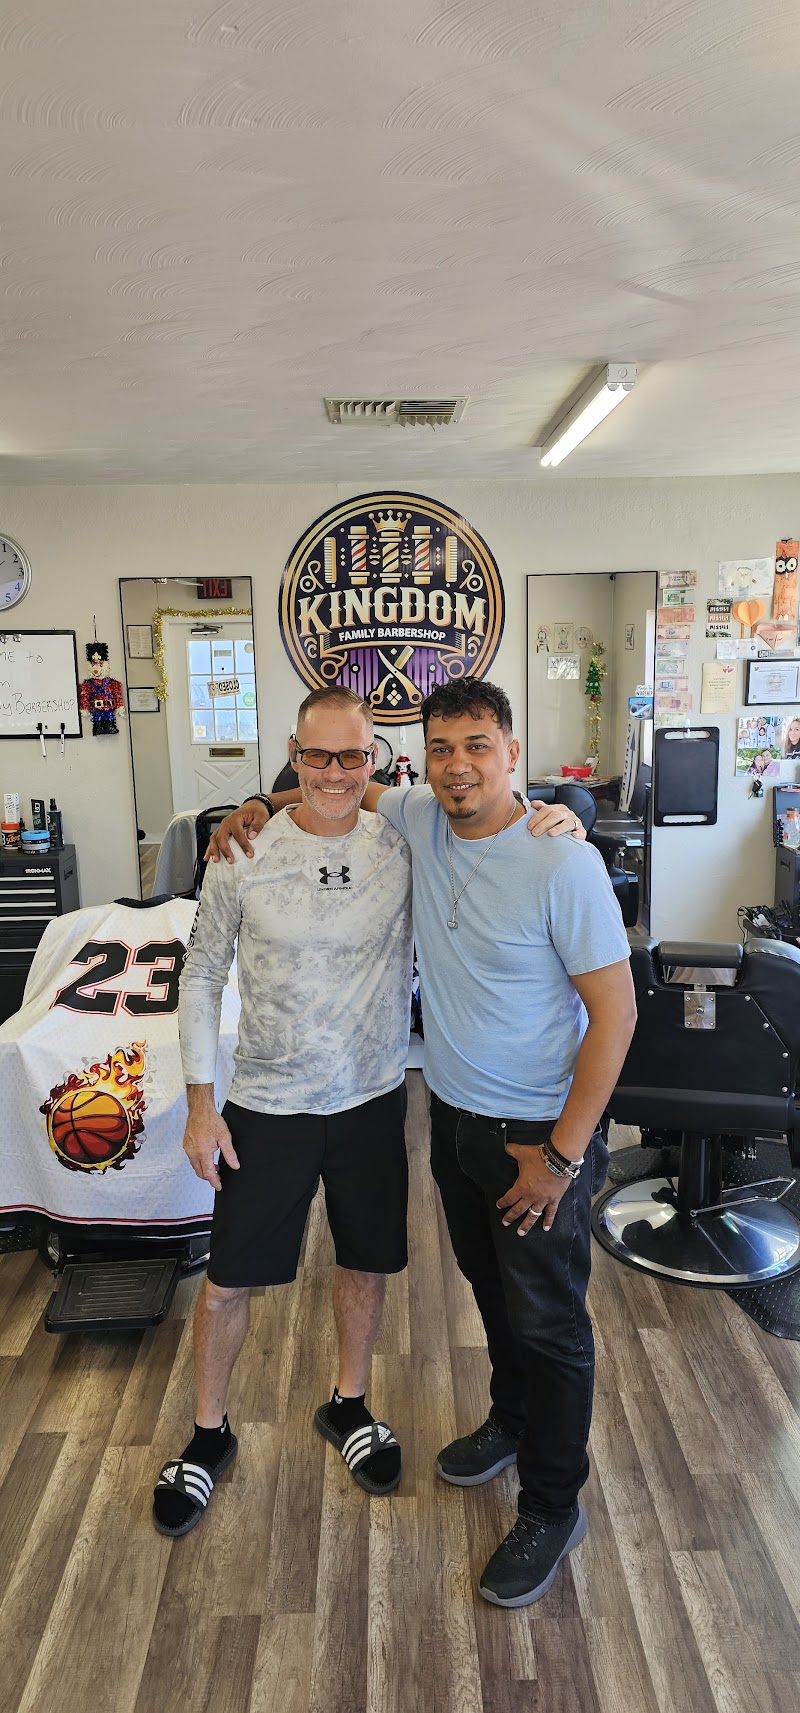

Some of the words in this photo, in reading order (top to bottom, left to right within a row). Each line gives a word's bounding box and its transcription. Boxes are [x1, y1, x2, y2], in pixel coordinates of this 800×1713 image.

[2, 543, 7, 552] 1
[12, 553, 19, 563] 2
[18, 567, 24, 577] 3
[14, 582, 21, 592] 4
[5, 592, 12, 603] 5
[298, 586, 487, 637] KINGDOM
[338, 627, 376, 642] FAMILY
[377, 627, 446, 641] BARBERSHOP
[48, 937, 183, 1017] 23
